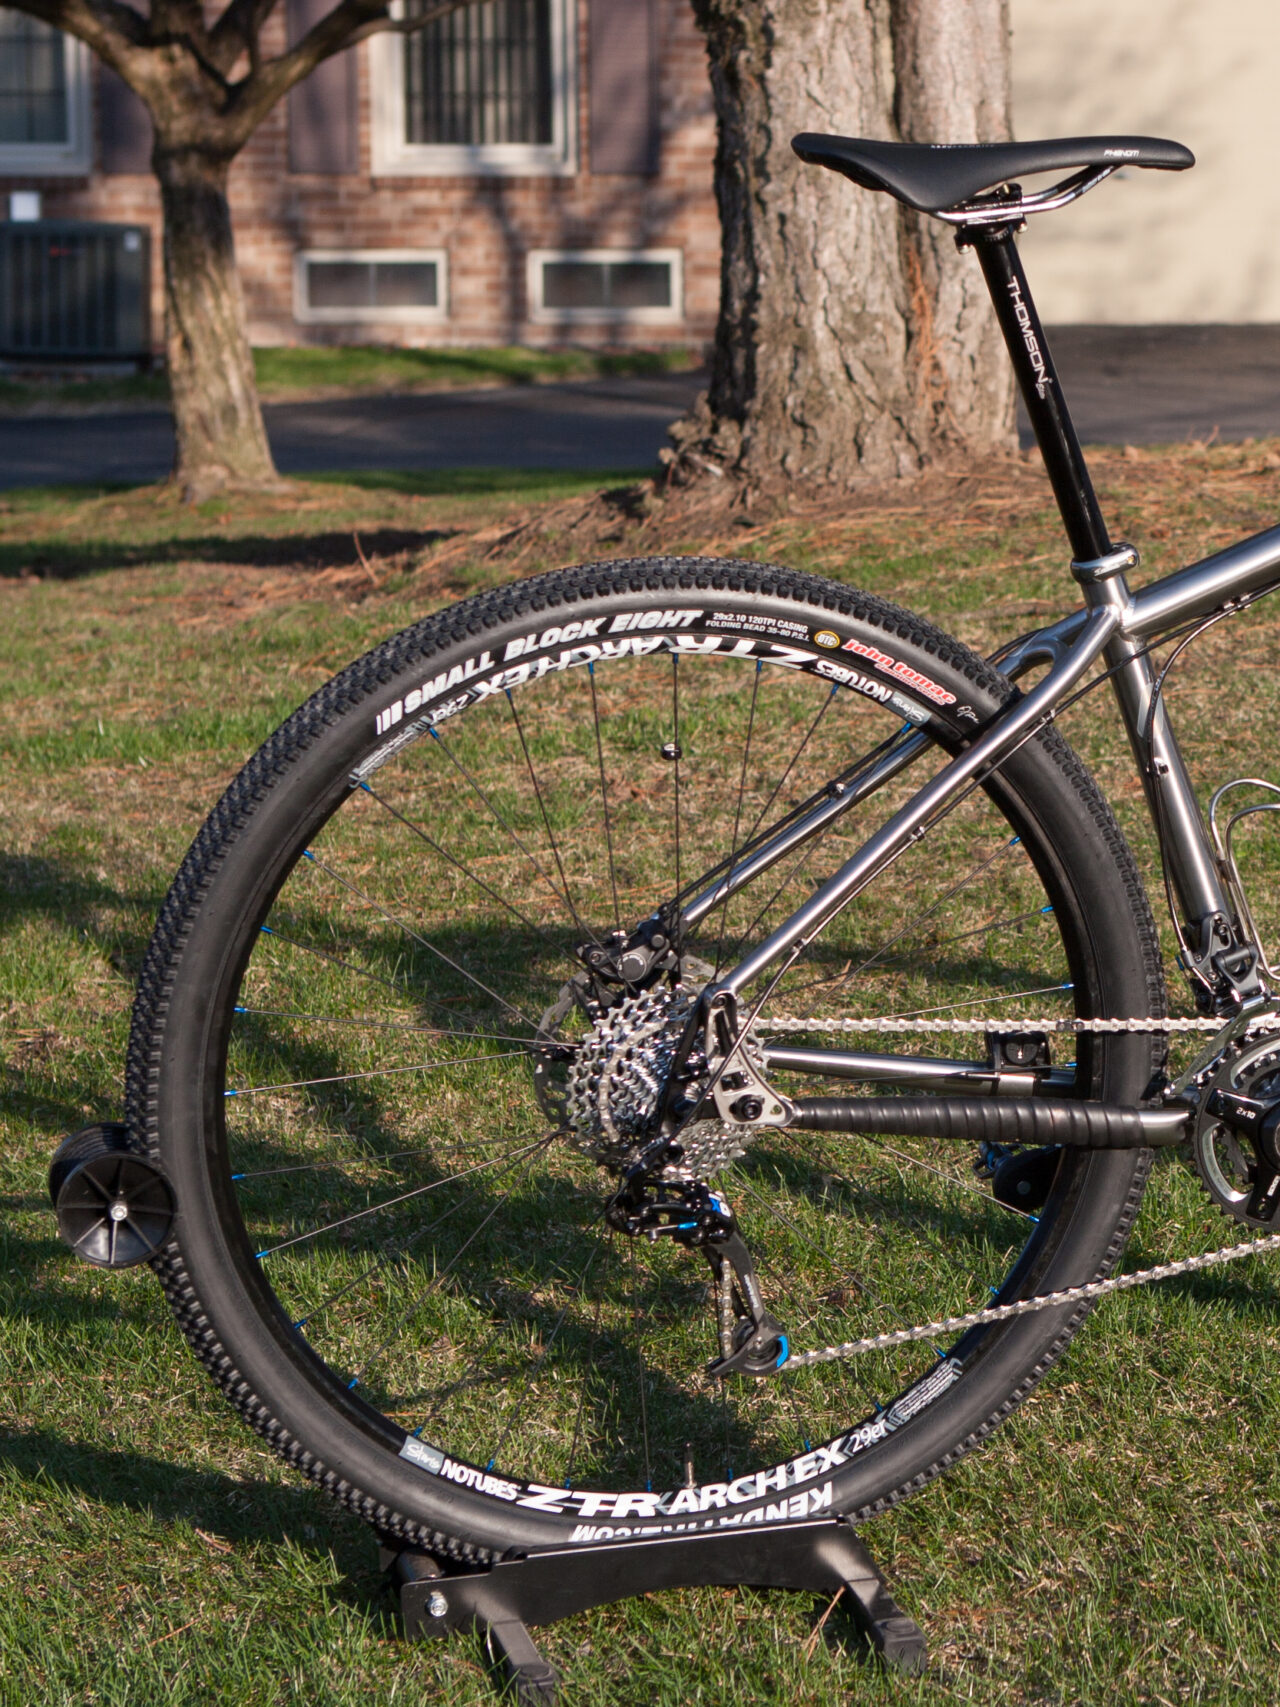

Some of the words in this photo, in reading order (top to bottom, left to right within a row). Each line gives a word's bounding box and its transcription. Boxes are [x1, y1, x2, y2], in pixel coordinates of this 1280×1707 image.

[1007, 275, 1049, 384] THOMSON
[705, 620, 742, 630] FOLDING
[743, 622, 766, 633] BEAD
[748, 615, 776, 627] 120TPI
[777, 620, 809, 634] CASING
[404, 651, 496, 714] SMALL
[503, 617, 608, 662] BLOCK
[607, 609, 704, 634] EIGHT
[669, 635, 819, 671] ZTR
[815, 659, 893, 703] NOTUBES
[440, 1459, 519, 1501] NOTUBES
[516, 1483, 662, 1518] ZTR
[850, 1419, 887, 1453] 29er
